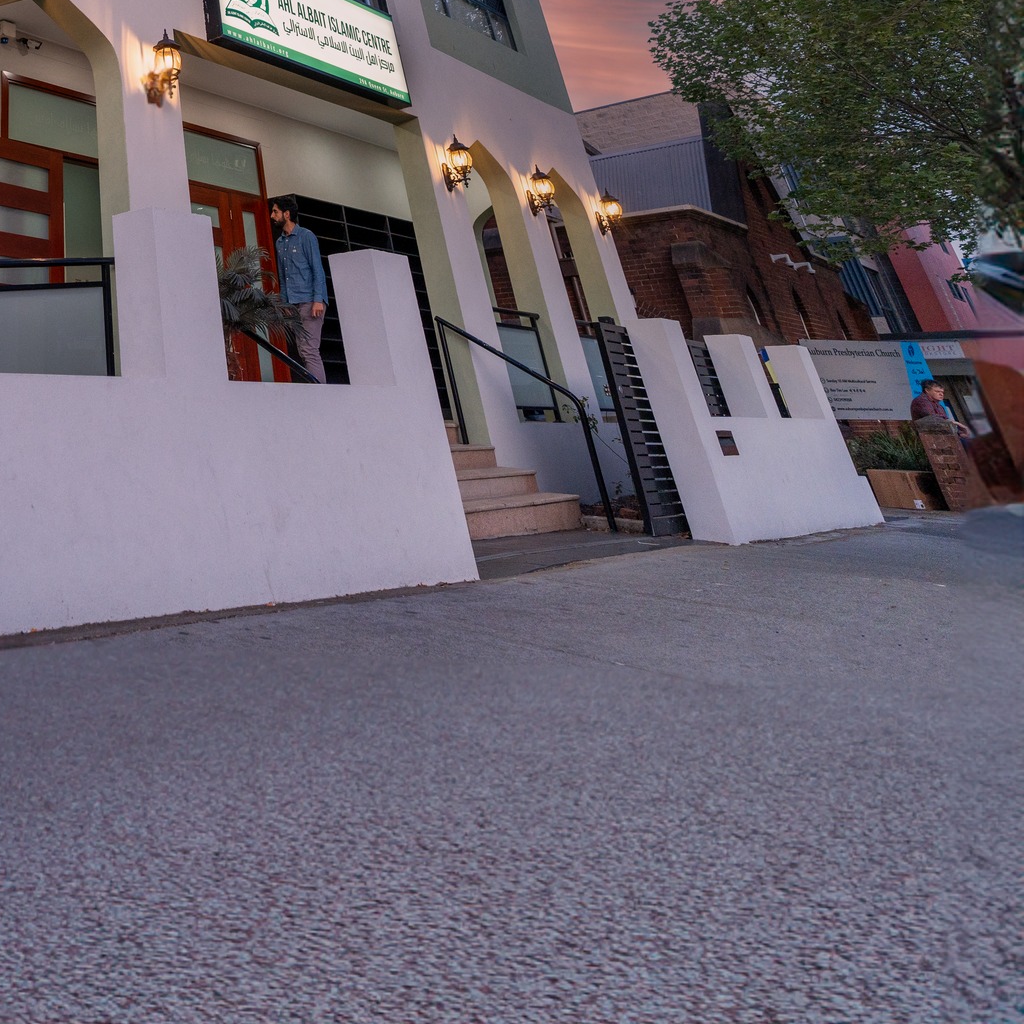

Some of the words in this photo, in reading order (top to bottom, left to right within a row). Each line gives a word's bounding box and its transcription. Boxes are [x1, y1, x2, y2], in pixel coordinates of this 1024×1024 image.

[283, 18, 316, 41] الاسترالي
[297, 2, 327, 28] ALBAIT
[328, 14, 362, 43] ISLAMIC
[362, 29, 393, 56] CENTRE
[226, 29, 289, 58] www.ahlalbait.org
[317, 35, 349, 54] الاسلامي
[348, 43, 365, 62] البيت
[378, 55, 395, 73] مركز
[832, 347, 875, 359] Presbyterian
[874, 348, 902, 358] Church
